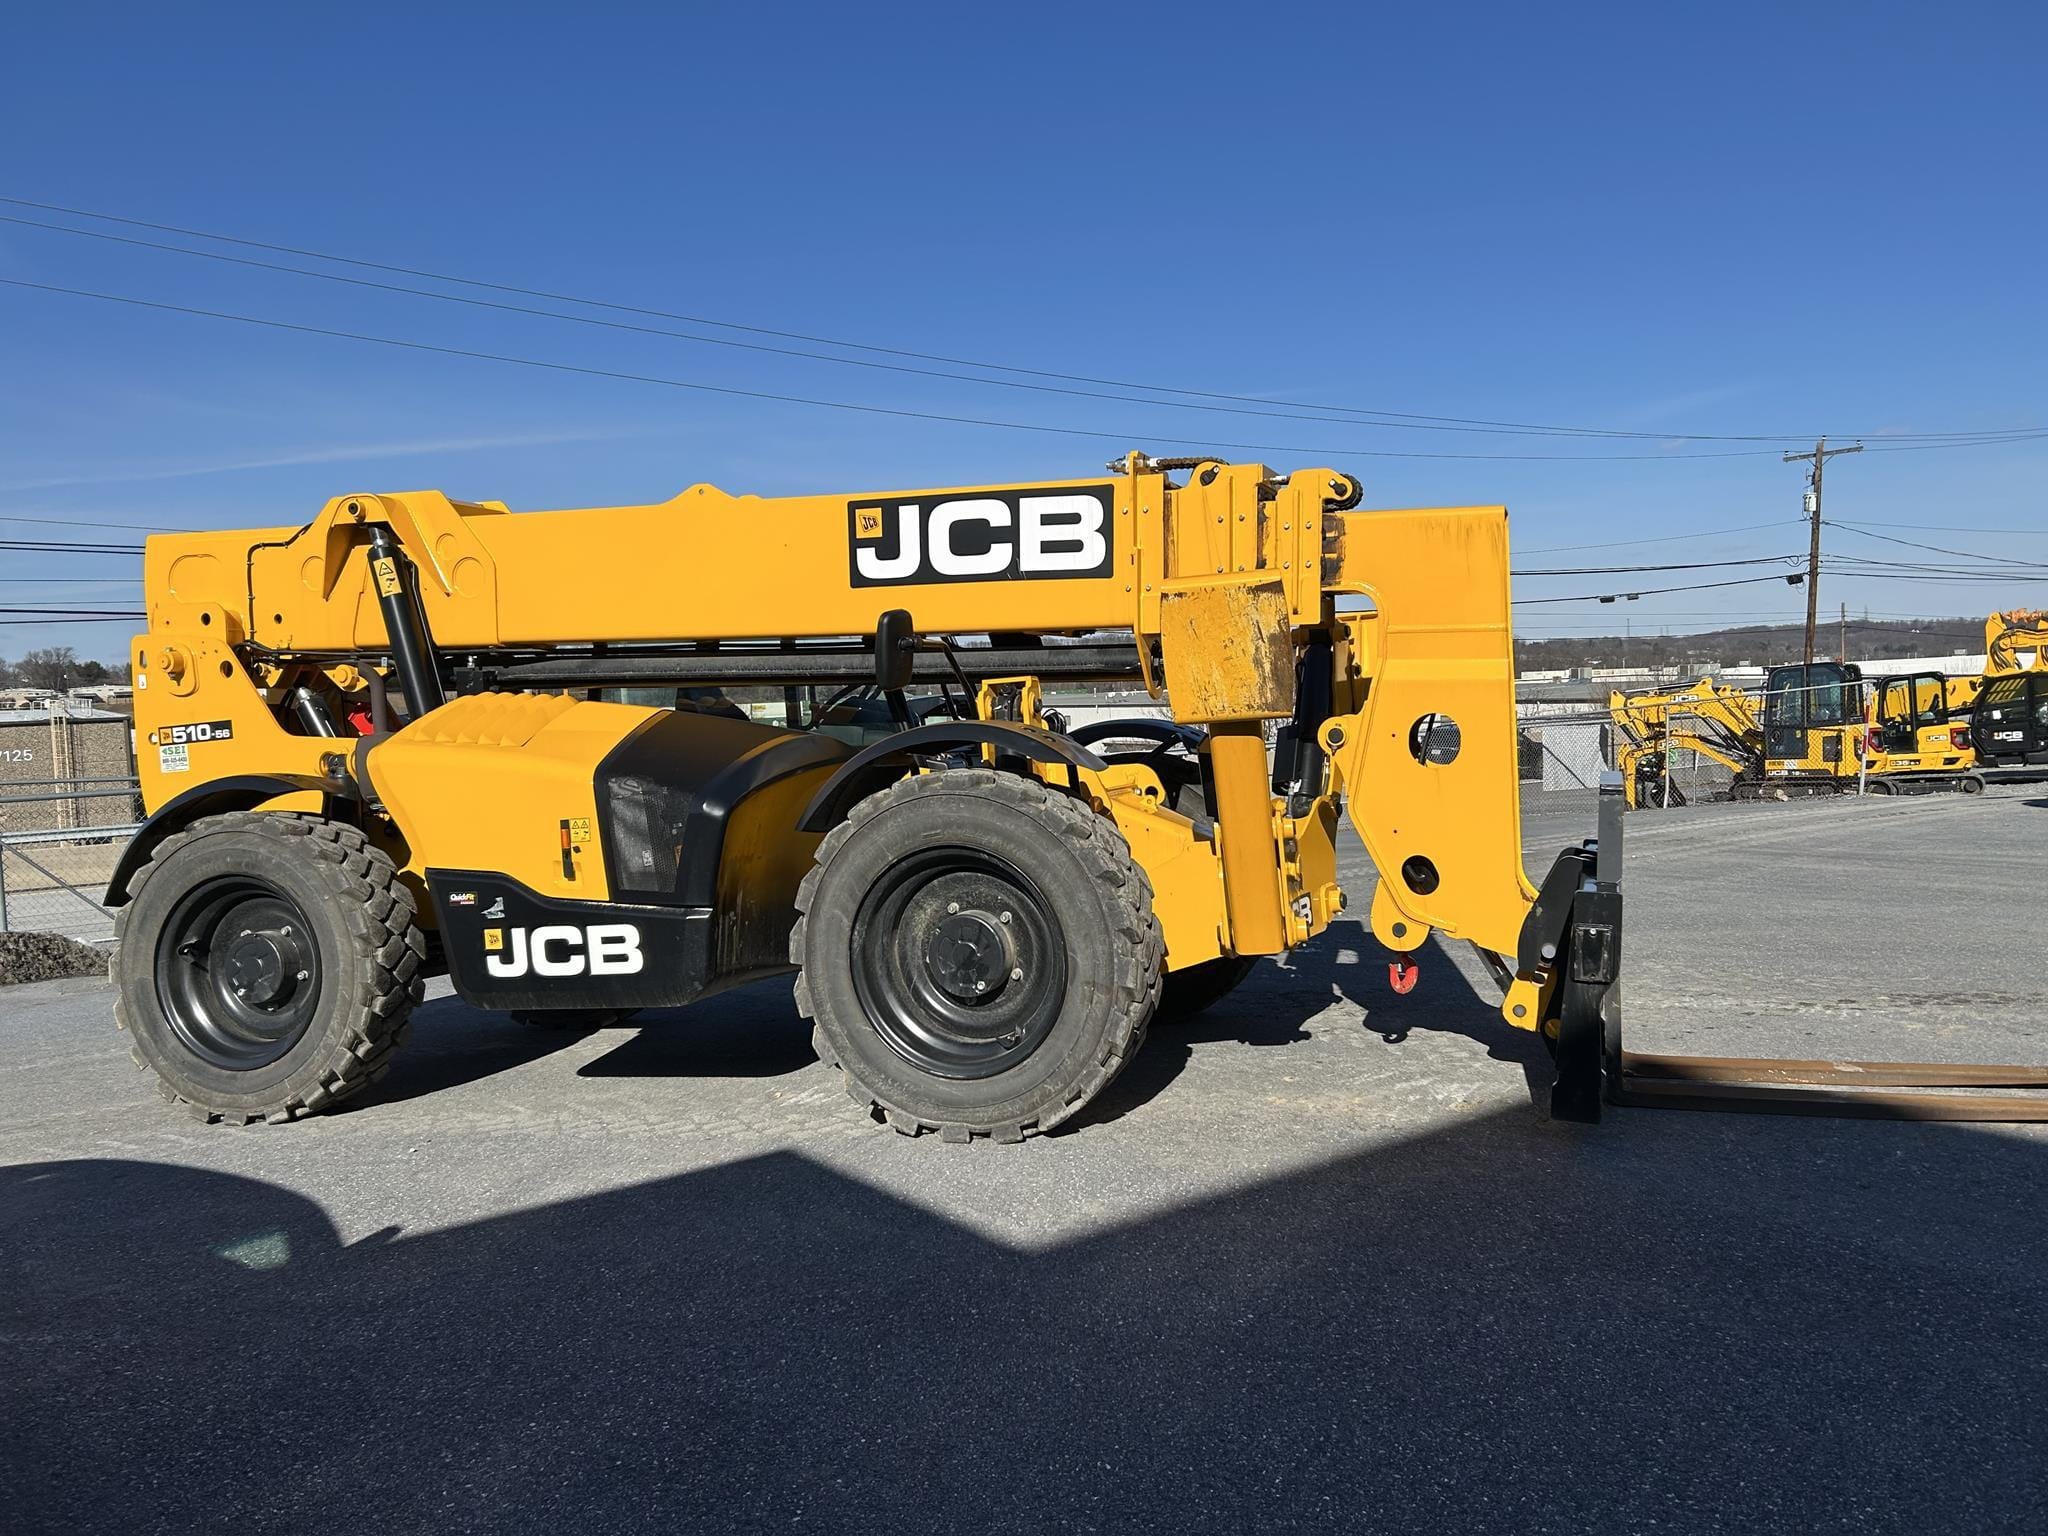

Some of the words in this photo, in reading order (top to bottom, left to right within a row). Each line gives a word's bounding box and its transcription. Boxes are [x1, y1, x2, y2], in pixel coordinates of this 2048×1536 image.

[856, 494, 1106, 580] JCB
[1670, 694, 1698, 703] JCB
[172, 723, 231, 743] 510-56
[1926, 734, 1948, 742] JCB
[1994, 730, 2024, 740] JCB
[0, 749, 33, 762] 125
[486, 923, 644, 978] JCB
